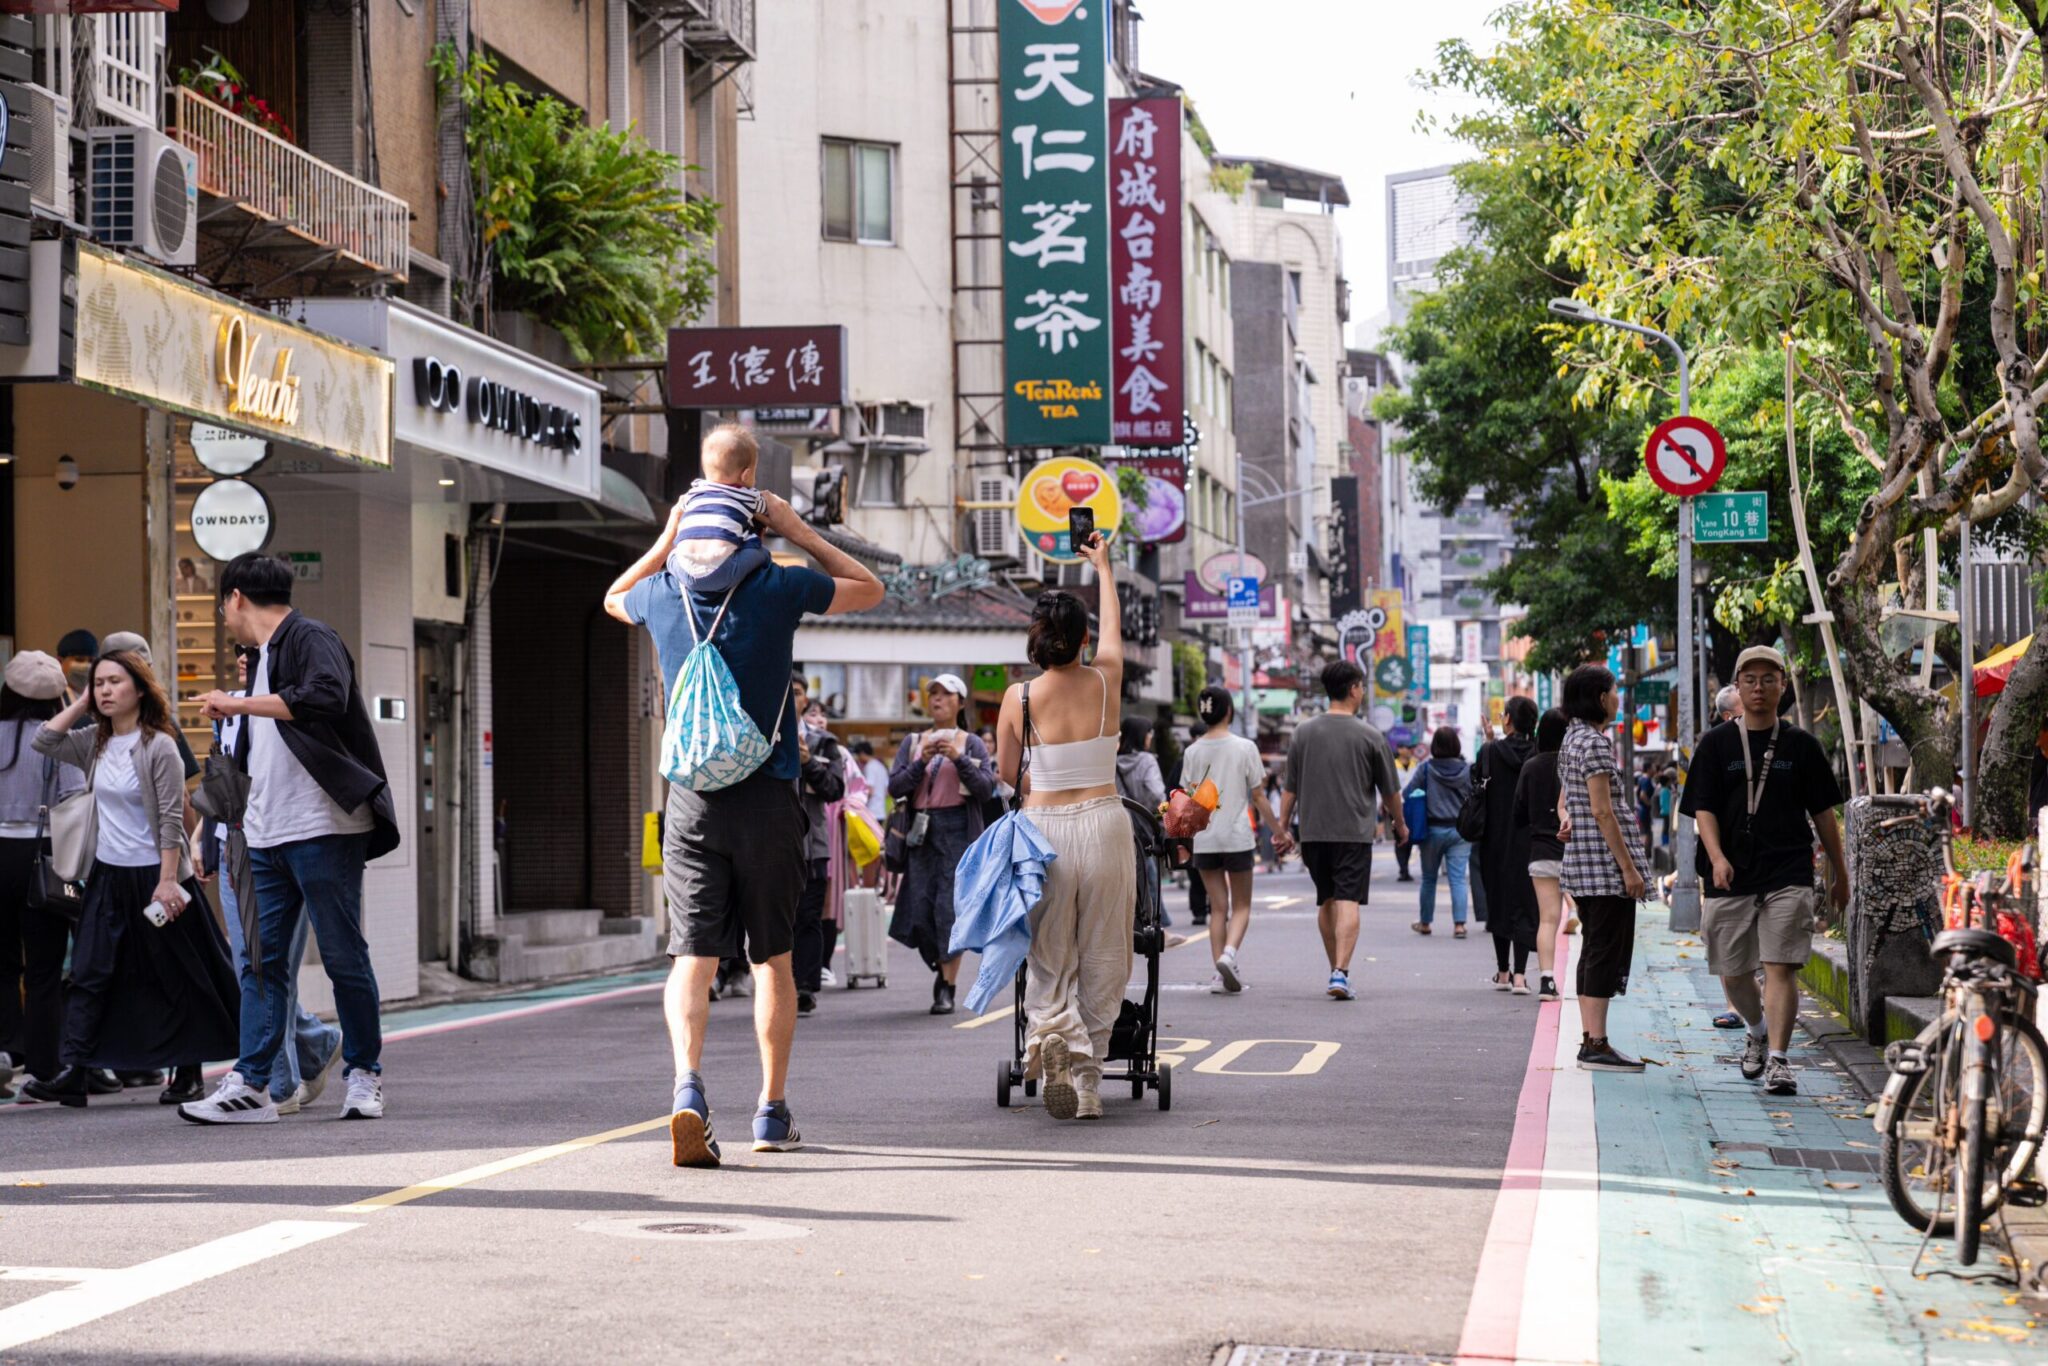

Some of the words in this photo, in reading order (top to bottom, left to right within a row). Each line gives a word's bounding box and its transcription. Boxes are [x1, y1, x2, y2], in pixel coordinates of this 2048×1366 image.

[1008, 43, 1102, 354] 天仁茗茶
[1114, 106, 1169, 414] 府城台南美食
[216, 314, 300, 426] Venchi
[1040, 405, 1079, 418] TEA
[195, 515, 266, 526] OWNDAYS
[1701, 520, 1717, 528] Lane
[1722, 511, 1739, 527] 10
[1702, 529, 1744, 538] YongKang
[1229, 579, 1245, 599] P
